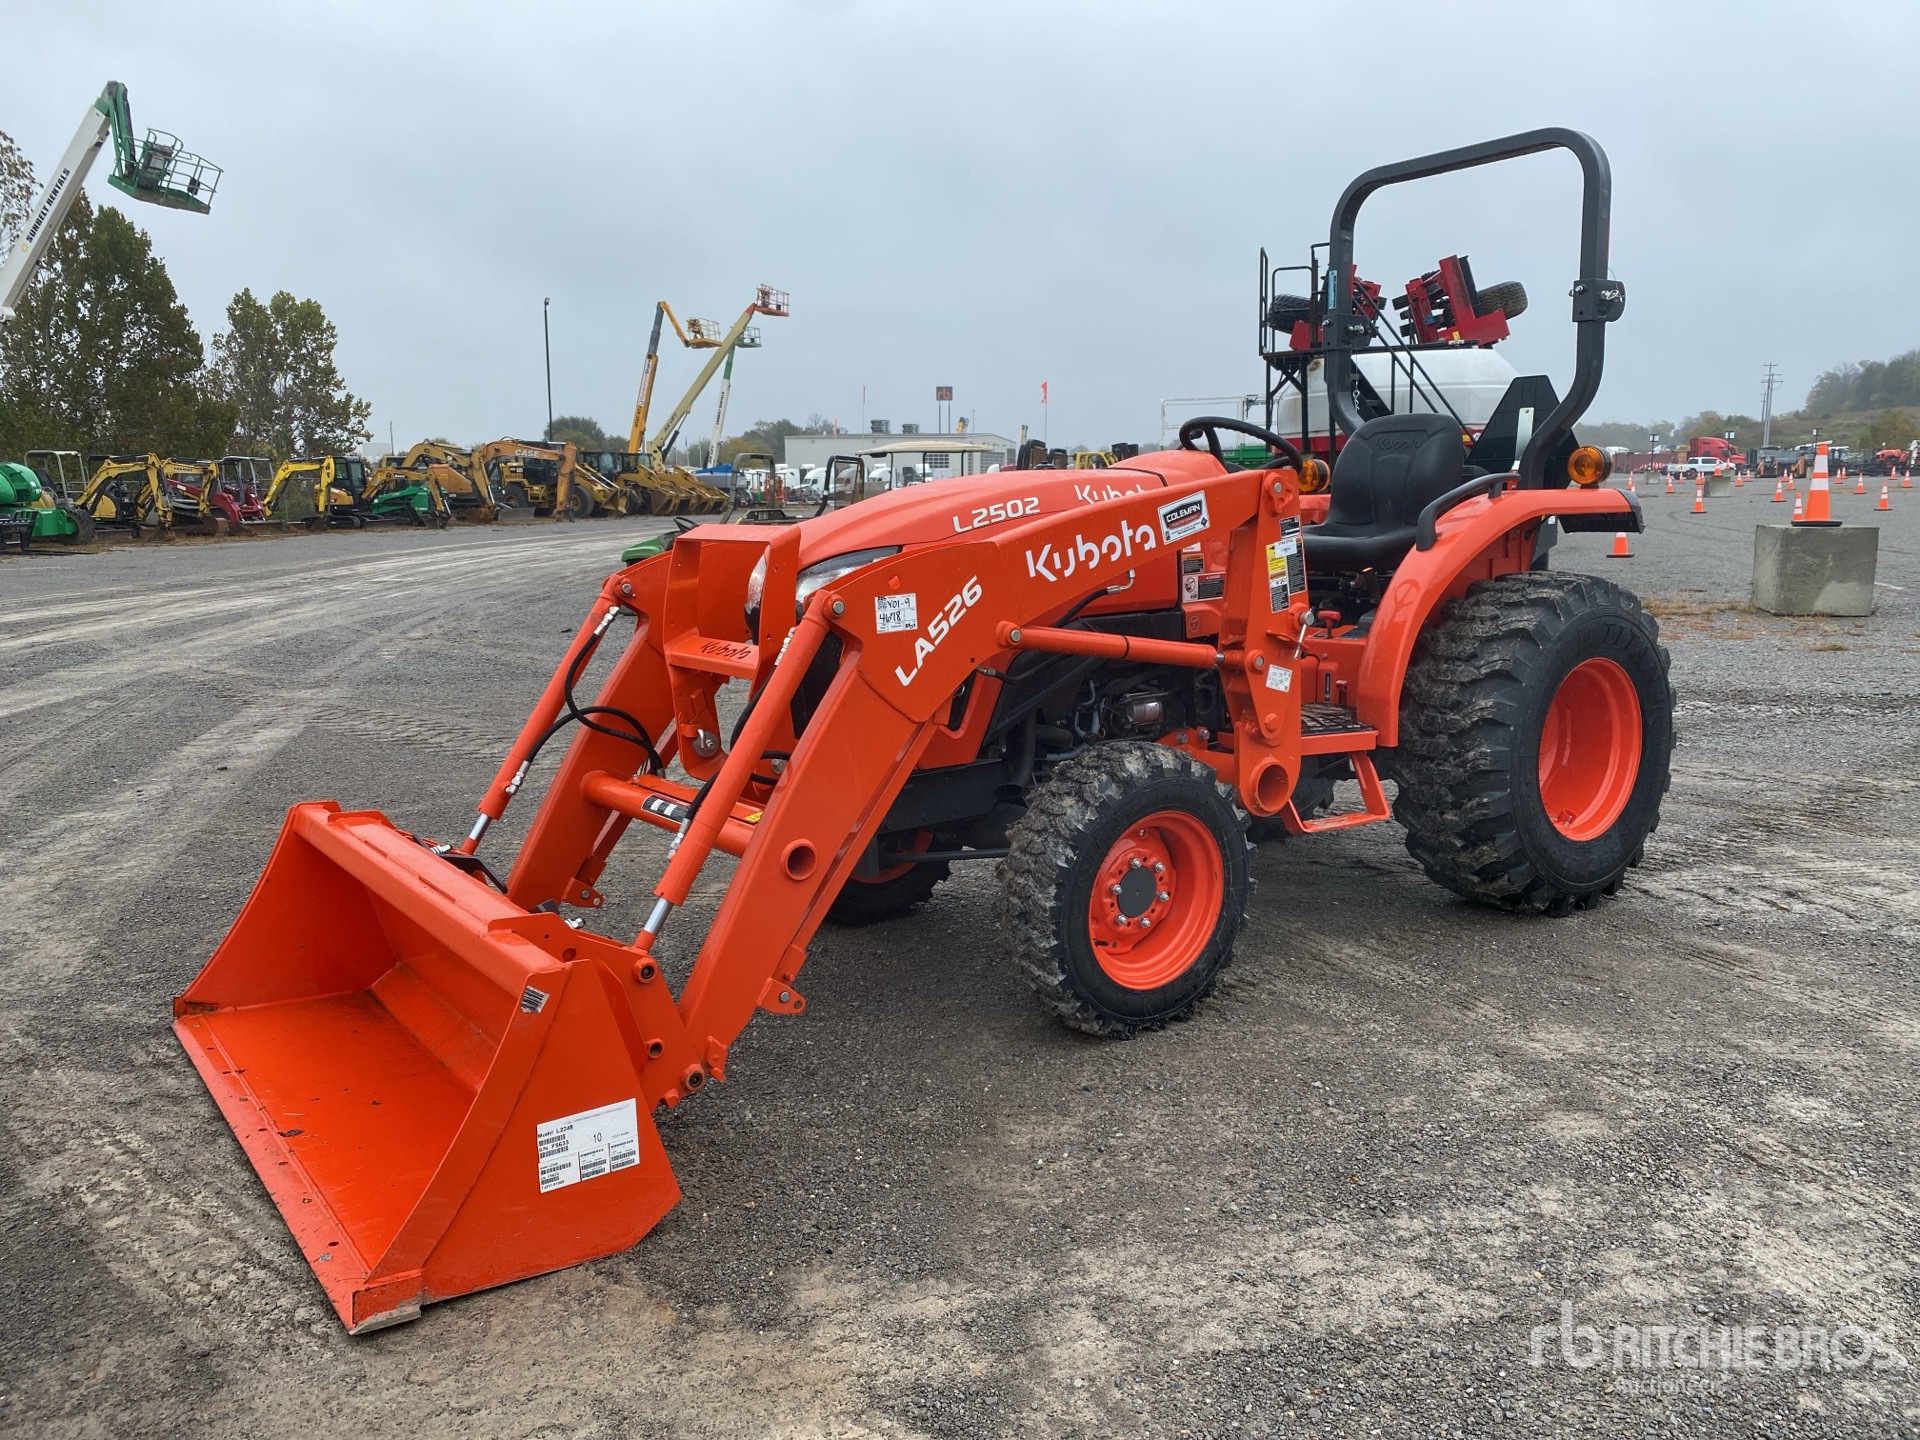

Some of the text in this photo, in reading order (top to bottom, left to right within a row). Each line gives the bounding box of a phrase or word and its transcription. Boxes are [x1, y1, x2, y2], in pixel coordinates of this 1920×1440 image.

[26, 168, 70, 243] SUNBELT RENTALS
[1376, 437, 1421, 449] Kubota
[515, 449, 540, 457] CASE
[952, 496, 1041, 534] L2502
[1166, 503, 1200, 522] COLEMAN
[1025, 520, 1156, 582] Kubota
[895, 575, 983, 687] LA526
[700, 641, 752, 659] Kubota
[593, 1132, 602, 1143] 10
